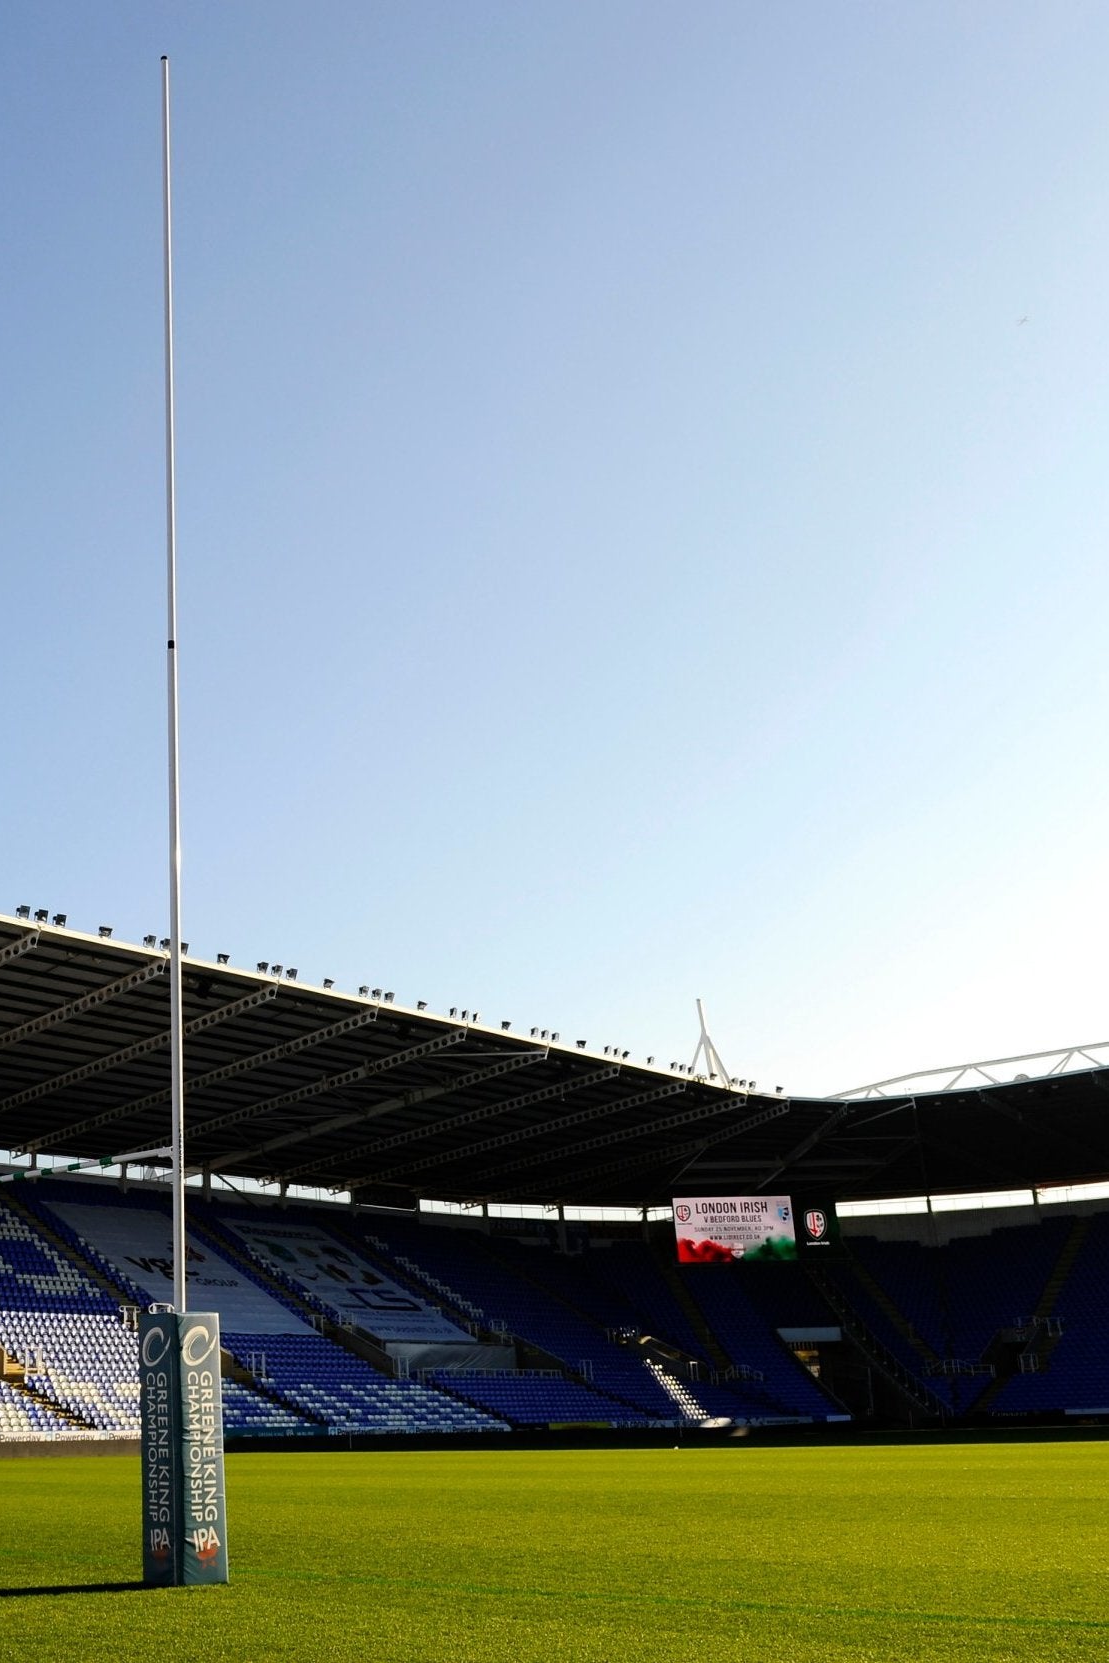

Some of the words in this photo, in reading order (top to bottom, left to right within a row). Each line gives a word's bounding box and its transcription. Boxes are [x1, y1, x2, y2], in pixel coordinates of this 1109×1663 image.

[695, 1202, 737, 1214] LONDON
[739, 1201, 768, 1214] IRISH
[710, 1215, 739, 1223] BEDFORD
[741, 1215, 762, 1223] BLUES
[157, 1371, 170, 1458] GREENE
[199, 1370, 216, 1458] GREENE
[0, 1434, 41, 1442] Powerday
[55, 1433, 95, 1441] Powerday
[145, 1371, 158, 1522] CHAMPIONSHIP
[187, 1371, 203, 1523] CHAMPIONSHIP
[158, 1464, 171, 1522] KING
[203, 1463, 218, 1522] KING
[150, 1528, 171, 1552] IPA
[193, 1525, 221, 1553] IPA
